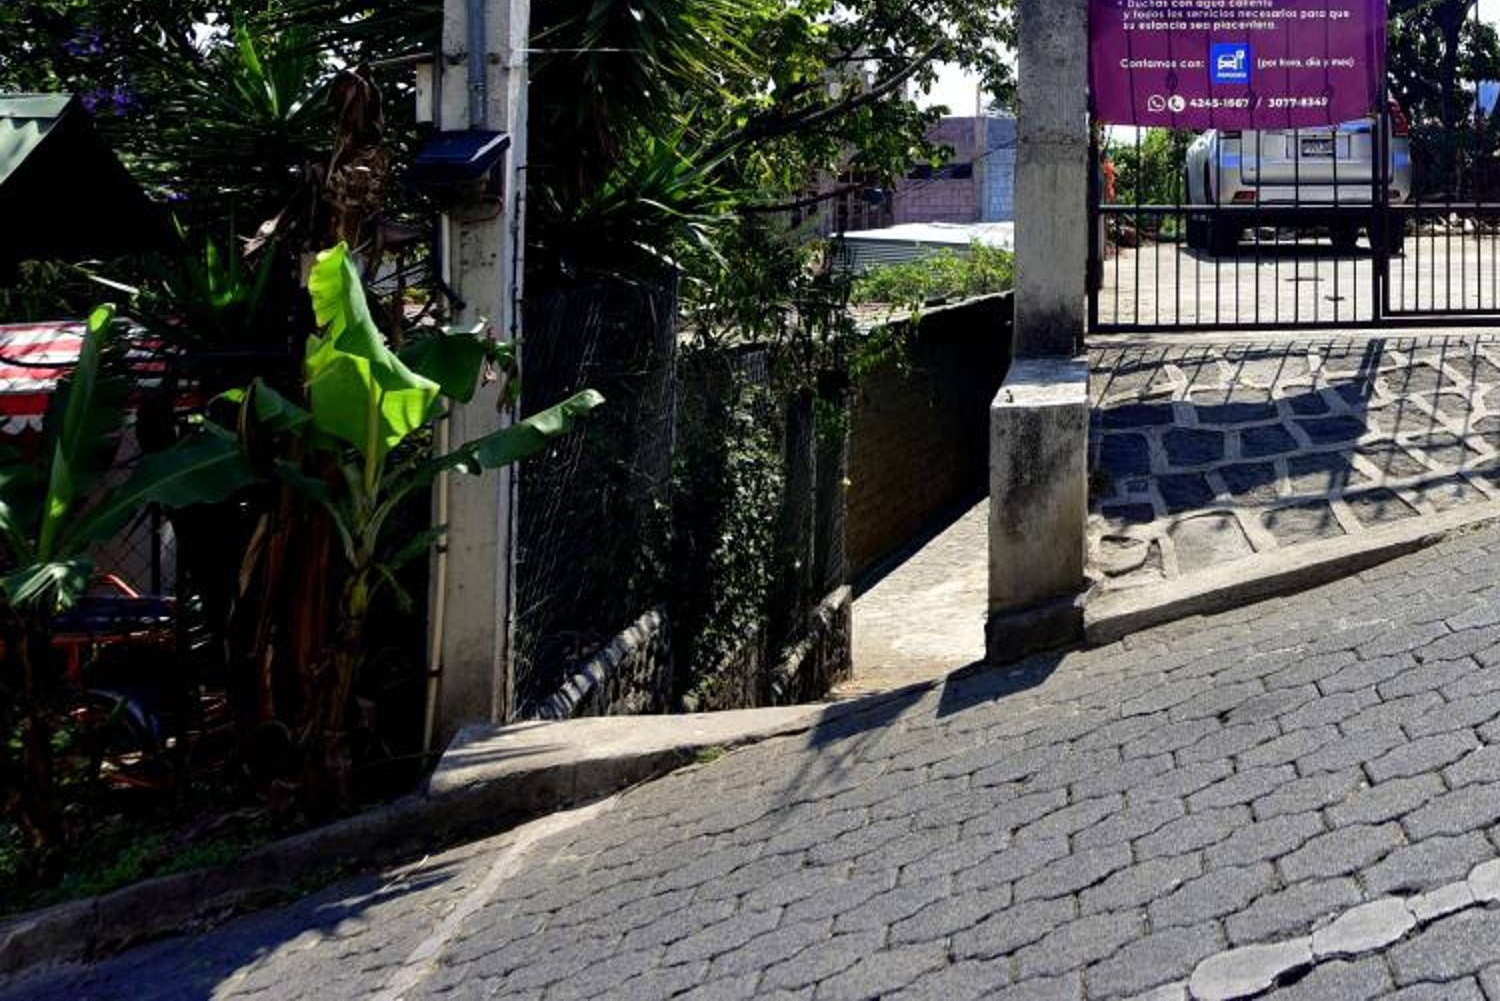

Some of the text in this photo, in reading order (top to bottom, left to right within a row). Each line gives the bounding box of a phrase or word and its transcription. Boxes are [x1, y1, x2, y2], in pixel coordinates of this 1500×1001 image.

[1127, 0, 1168, 8] Duchas
[1171, 0, 1192, 7] con
[1196, 0, 1225, 9] agua
[1123, 9, 1350, 20] y todos los servicios necesarios para que
[1138, 21, 1187, 30] estancia
[1189, 21, 1210, 30] sea
[1120, 58, 1205, 68] Contamos con:
[1257, 57, 1276, 70] (por
